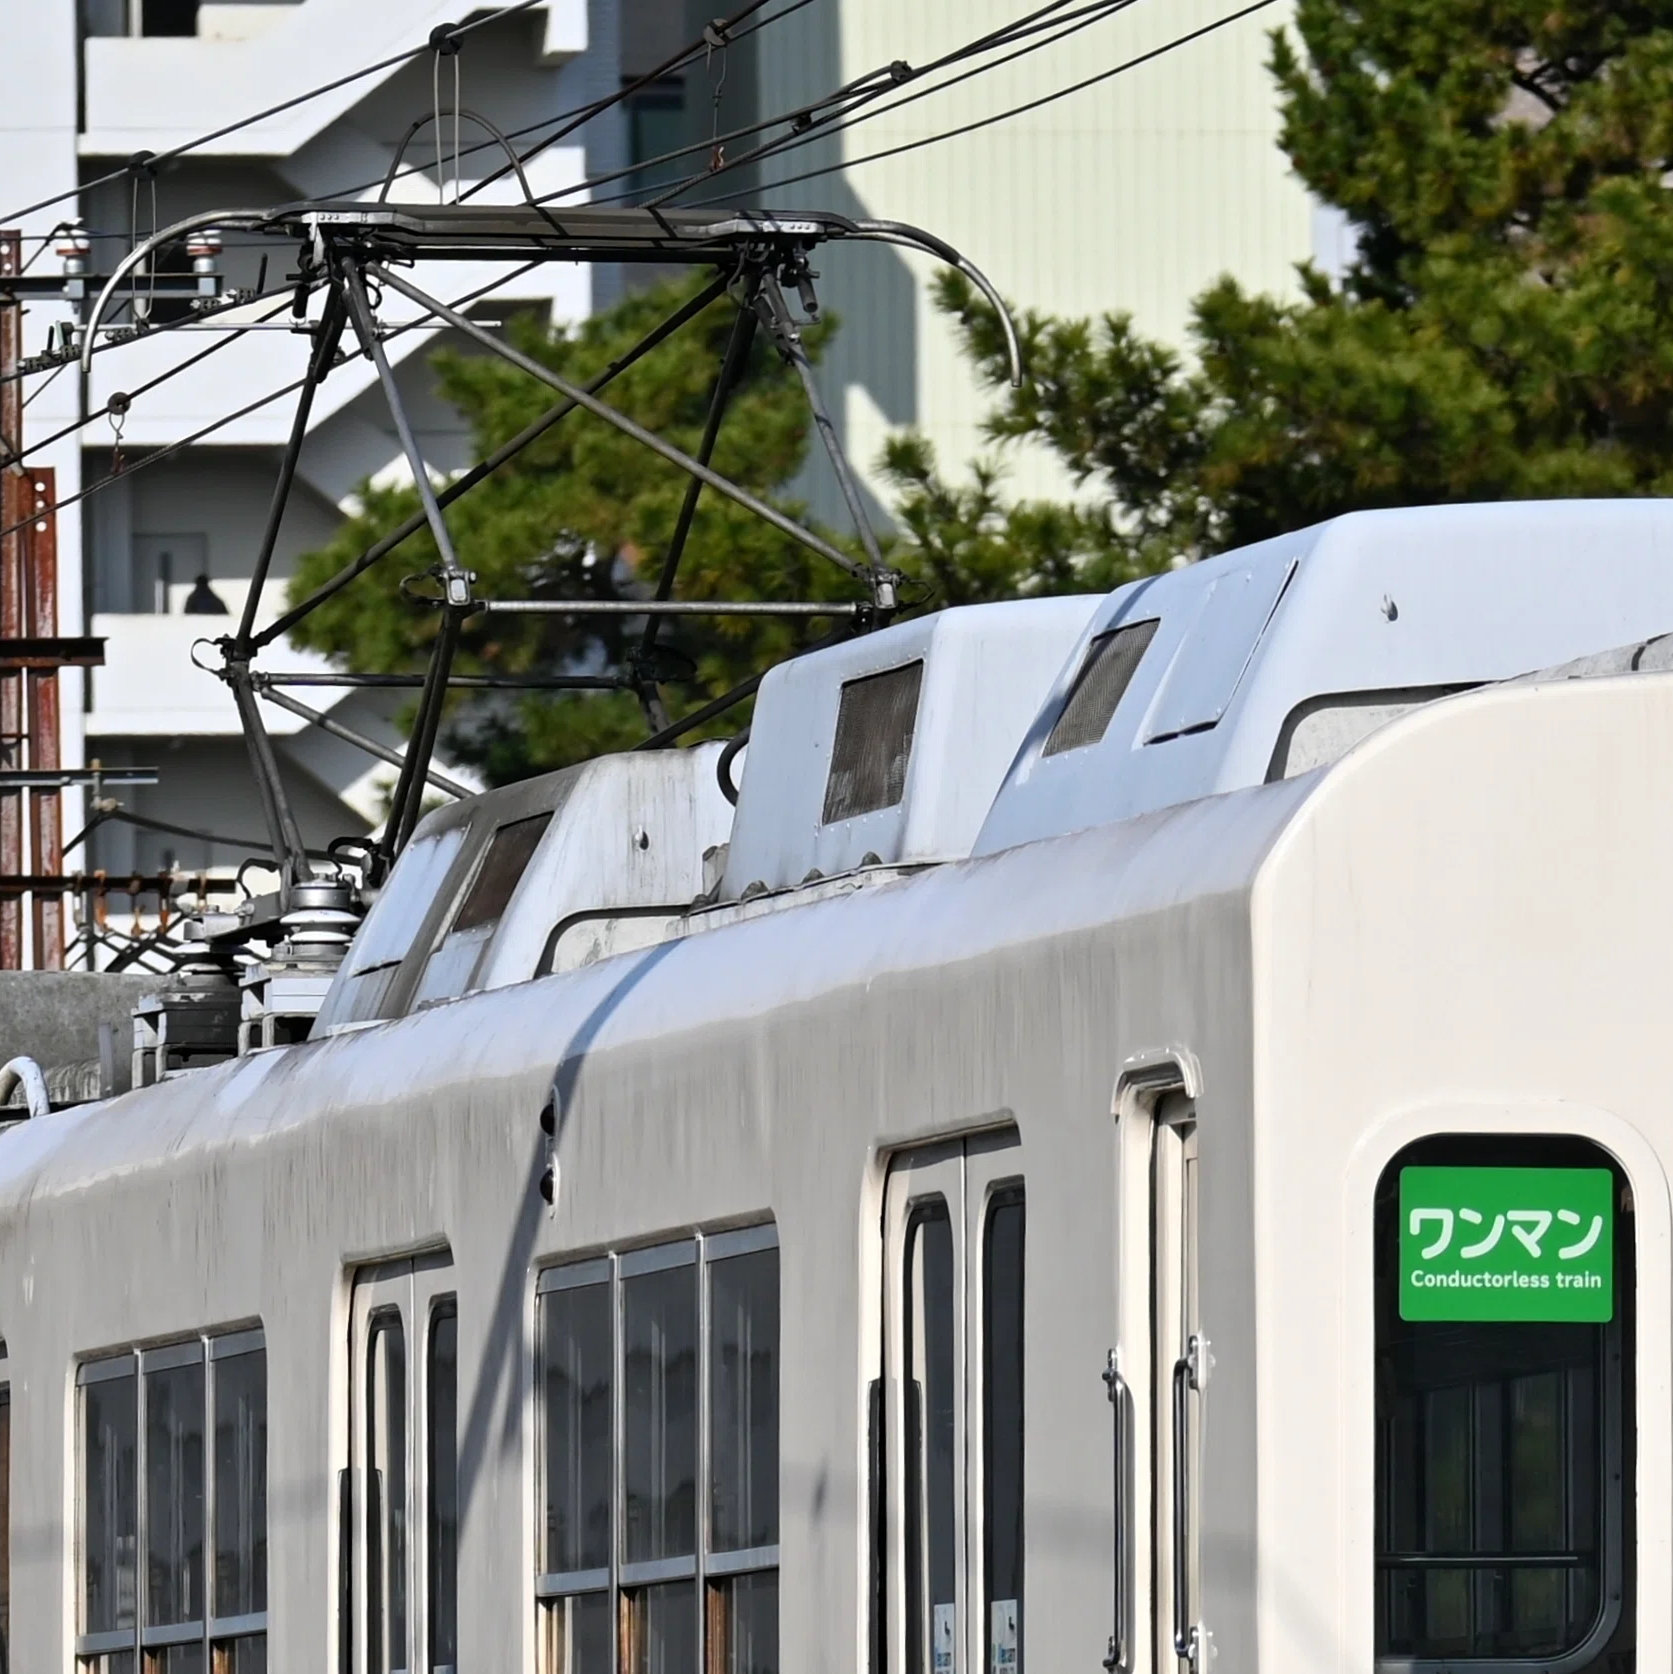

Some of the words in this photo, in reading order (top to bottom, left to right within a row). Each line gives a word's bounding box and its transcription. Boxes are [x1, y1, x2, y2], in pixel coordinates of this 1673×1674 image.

[1409, 1207, 1603, 1260] ワンマン
[1411, 1269, 1550, 1289] Conductorless
[1556, 1271, 1602, 1289] train
